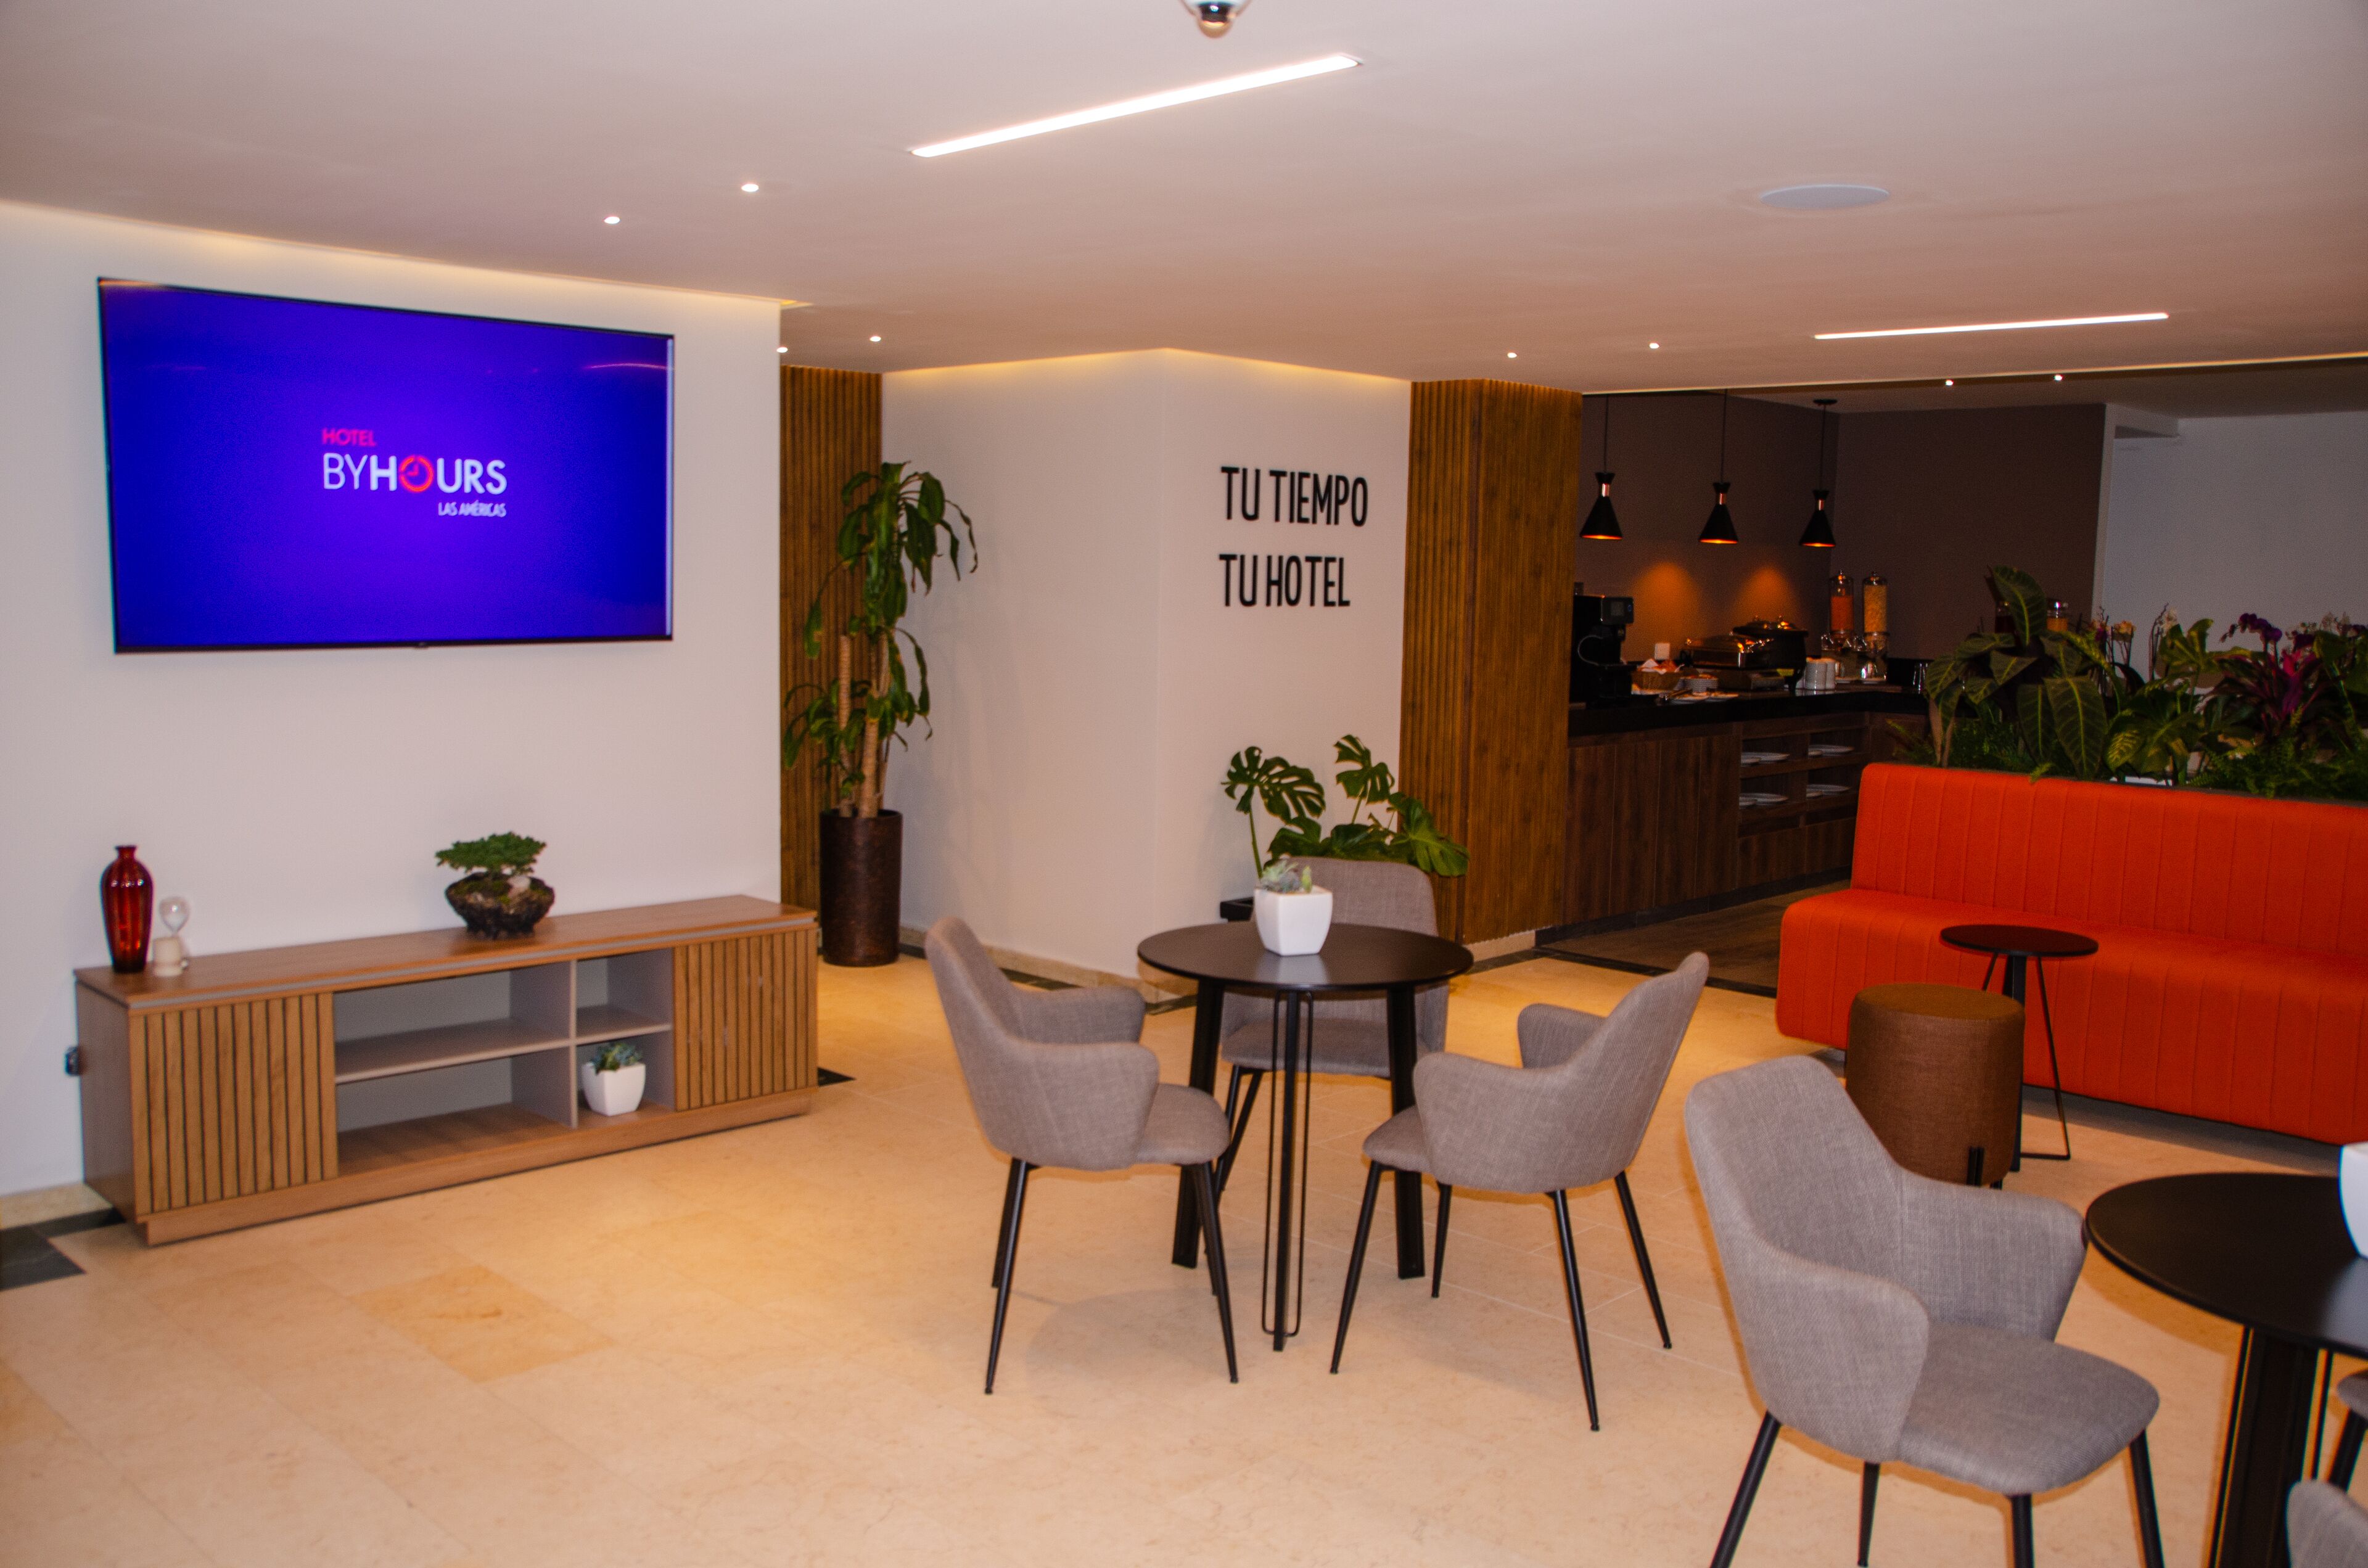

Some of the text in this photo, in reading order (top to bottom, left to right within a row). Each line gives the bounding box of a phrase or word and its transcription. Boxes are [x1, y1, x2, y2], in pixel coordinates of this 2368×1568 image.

[322, 429, 376, 446] HOTEL
[323, 452, 508, 495] BYHOURS
[438, 502, 456, 515] LAS
[1220, 466, 1368, 527] TU TIEMPO
[1219, 554, 1350, 607] TU HOTEL
